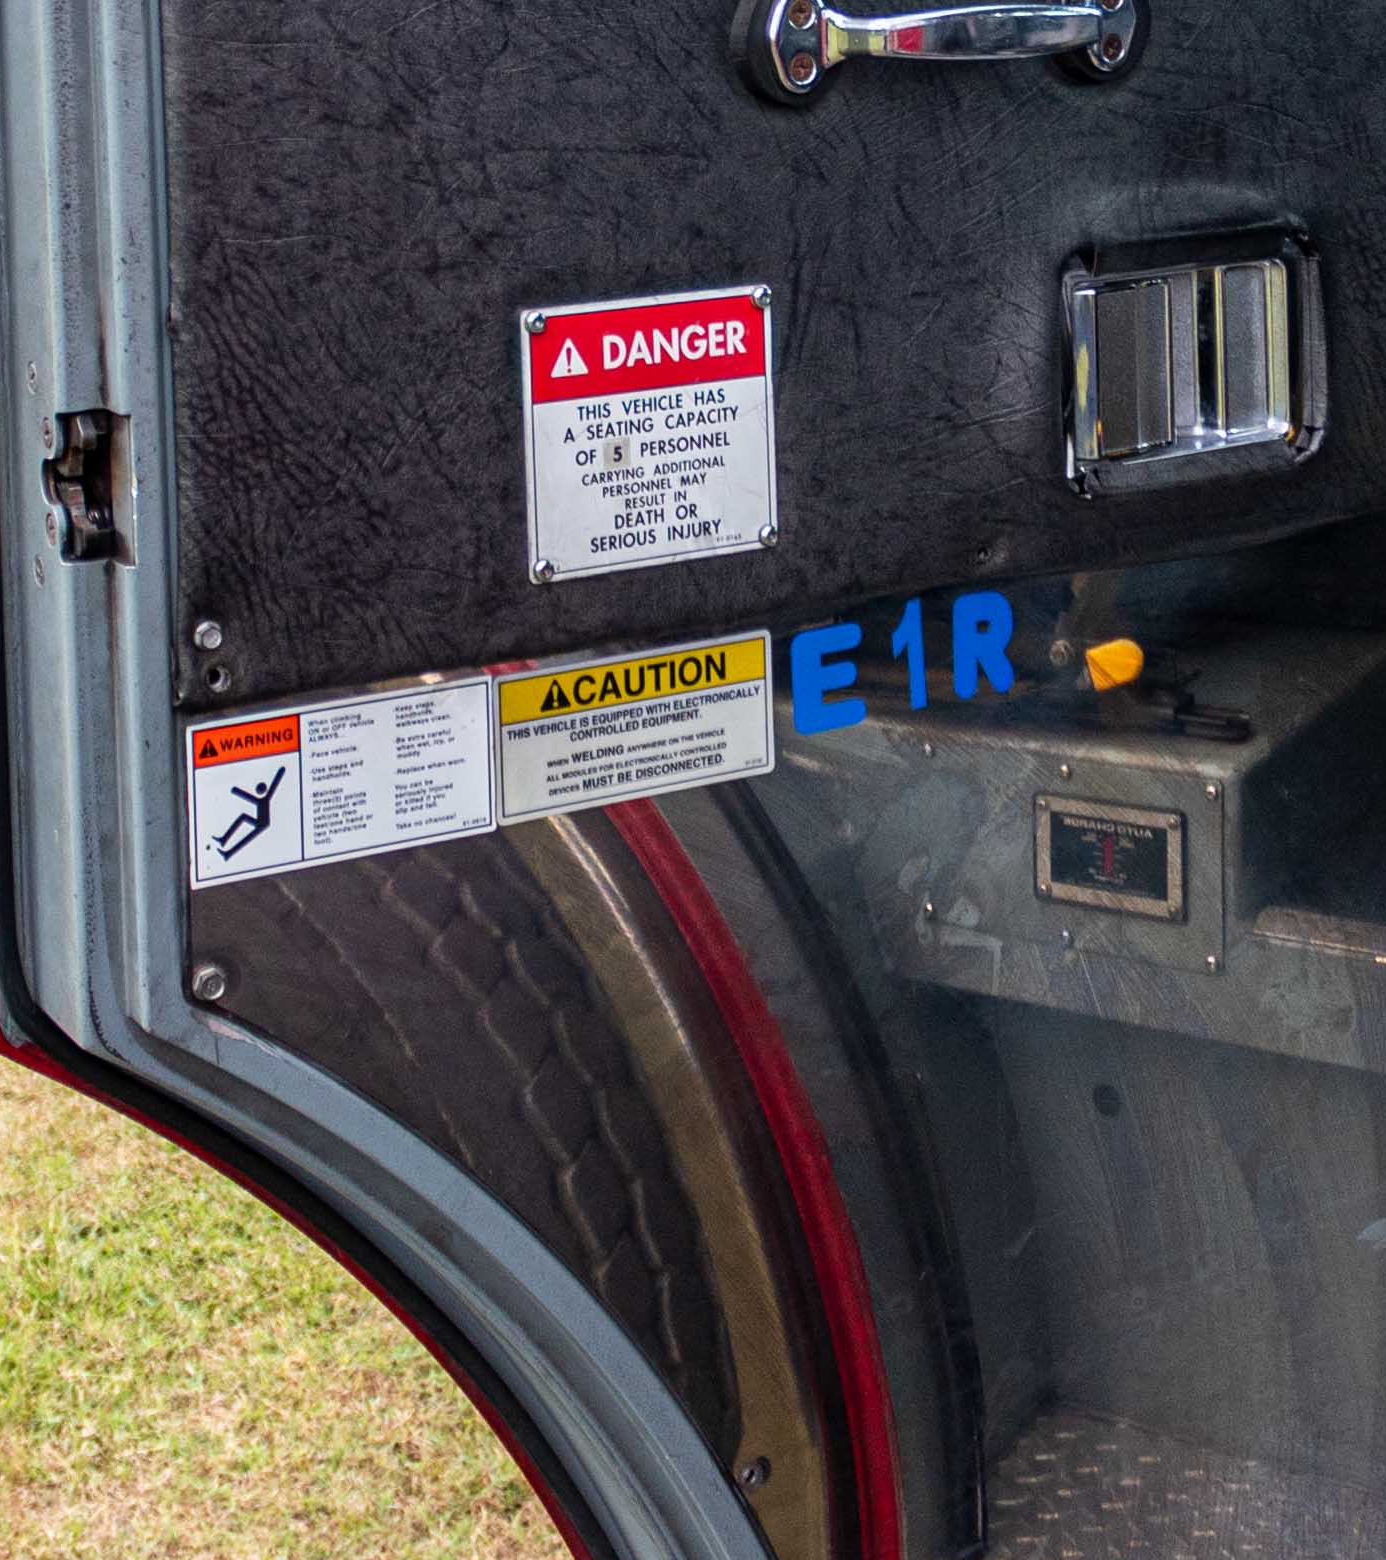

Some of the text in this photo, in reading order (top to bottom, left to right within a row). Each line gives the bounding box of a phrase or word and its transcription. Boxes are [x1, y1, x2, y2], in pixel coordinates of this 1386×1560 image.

[602, 320, 746, 370] DANGER
[578, 389, 725, 421] THIS VEHICLE HAS
[564, 407, 738, 443] A SEATING CAPACITY
[575, 432, 730, 466] OF 5 PERSONNEL
[582, 456, 725, 486] CARRYING ADDITIONAL
[602, 473, 706, 498] PERSONNEL MAY
[614, 504, 698, 529] DEATH OR
[625, 491, 686, 510] RESULT IN
[590, 532, 656, 553] SERIOUS
[667, 520, 721, 540] INJURY
[573, 652, 726, 705] CAUTION
[507, 686, 759, 741] THIS VEHICLE IS EQUIPPED WITH ELECTRONICALLY
[570, 707, 701, 742] CONTROLLED EQUIPMENT.
[220, 728, 293, 752] WARNING
[547, 727, 725, 768] WHEN WELDING ANYWHERE ON THE VEHICLE
[547, 741, 726, 783] ALL MODULES FOR ELECTRONICALLY CONTROLLED
[548, 752, 725, 796] DEVICES MUST BE DISCONNECTED.
